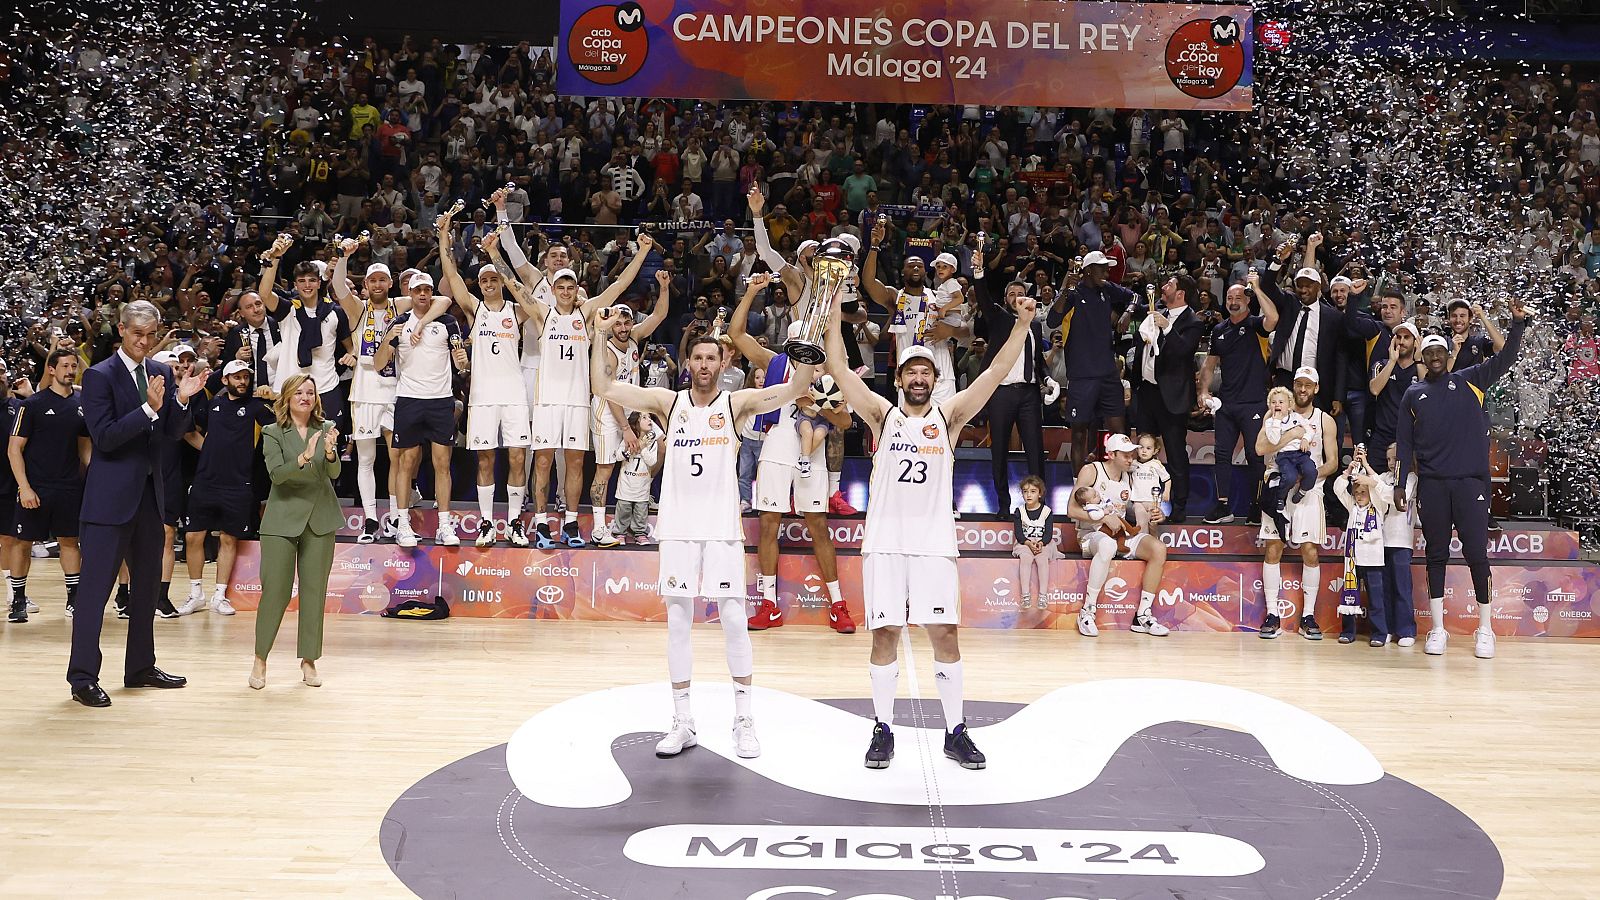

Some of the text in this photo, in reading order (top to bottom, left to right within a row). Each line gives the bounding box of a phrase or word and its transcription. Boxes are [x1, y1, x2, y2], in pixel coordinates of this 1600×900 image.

[591, 28, 611, 37] acb
[672, 13, 1142, 51] CAMPEONES COPA DEL REY
[582, 36, 622, 50] Copa
[584, 49, 627, 65] del Rey
[1179, 50, 1218, 64] Copa
[828, 51, 942, 82] Málaga
[1198, 64, 1224, 79] Rey
[658, 220, 711, 230] UNICAJA
[479, 330, 515, 339] AUTOHERO
[548, 334, 586, 342] AUTOHERO
[491, 341, 501, 355] 6
[559, 344, 575, 361] 14
[673, 436, 729, 448] AUTOHERO
[889, 442, 945, 456] AUTOHERO
[634, 457, 641, 472] 7
[690, 453, 704, 477] 5
[897, 458, 928, 484] 23
[340, 562, 371, 571] SPALDING
[383, 558, 410, 568] divina
[474, 566, 511, 579] Unicaja
[523, 563, 579, 577] endesa
[235, 583, 262, 591] ONEBO
[395, 588, 423, 596] Transaher
[635, 581, 659, 591] Movi
[1509, 586, 1532, 595] renfe
[463, 590, 502, 603] IONOS
[1189, 592, 1231, 603] Movistar
[1546, 594, 1576, 602] LOTUS
[1559, 610, 1592, 618] ONEBOX
[686, 835, 1039, 865] Málaga
